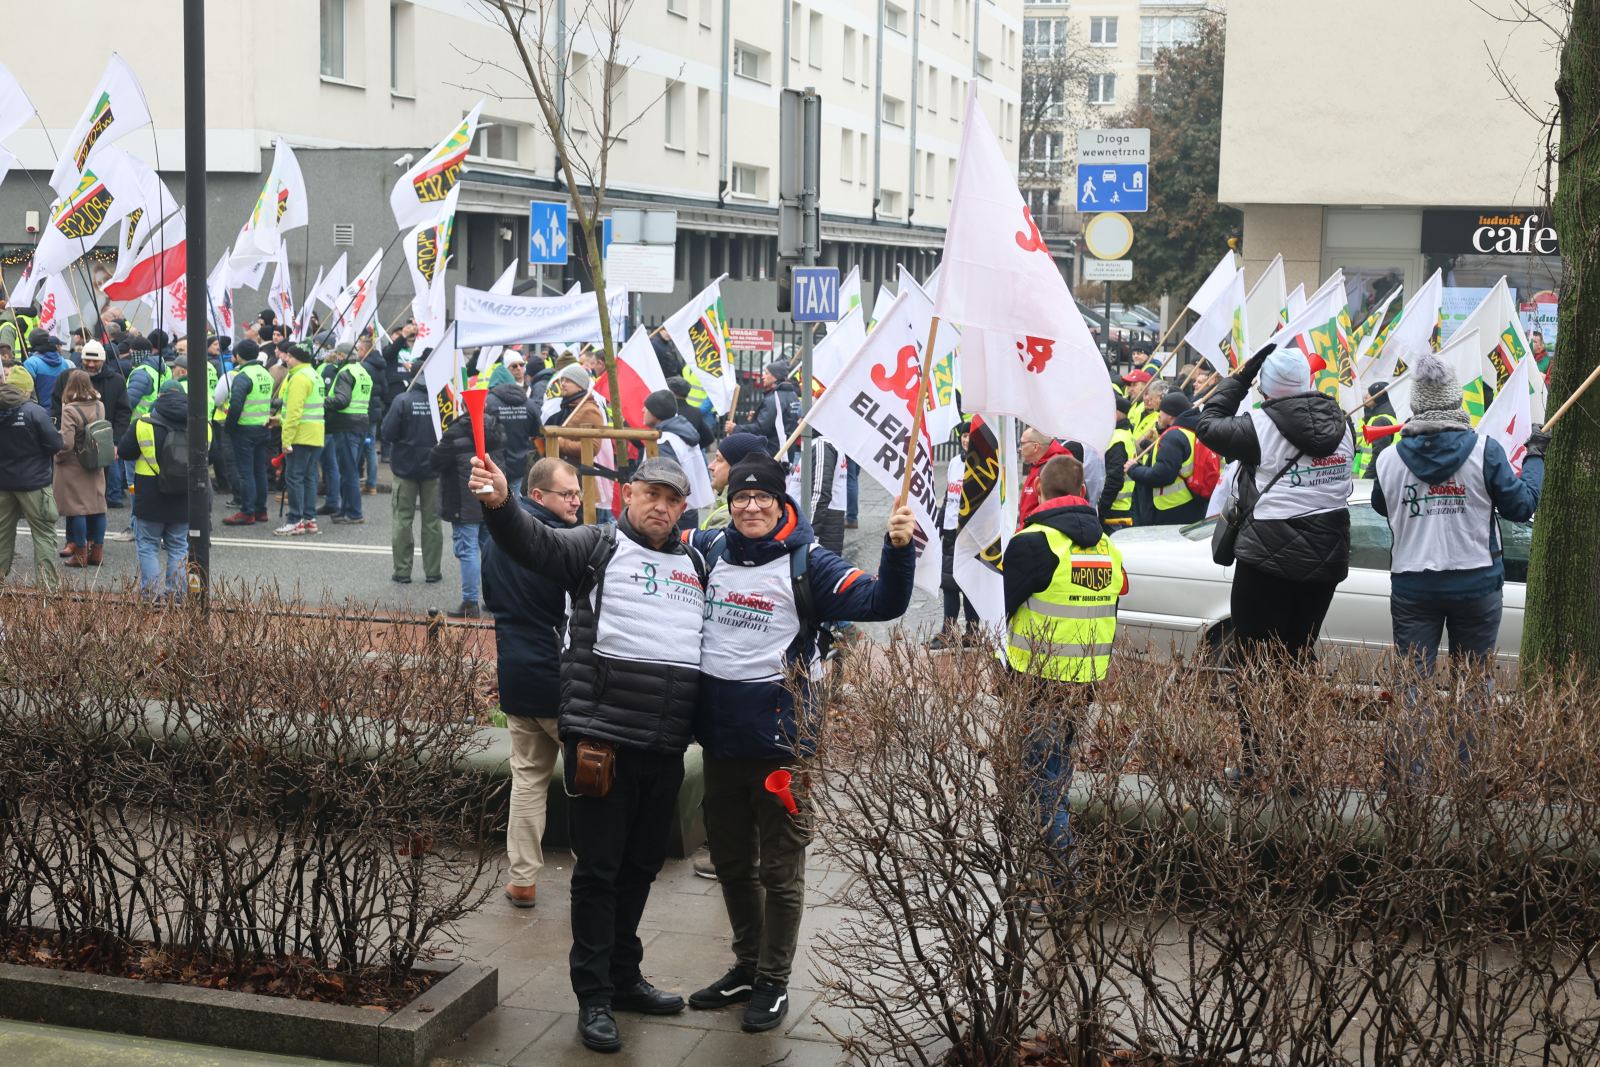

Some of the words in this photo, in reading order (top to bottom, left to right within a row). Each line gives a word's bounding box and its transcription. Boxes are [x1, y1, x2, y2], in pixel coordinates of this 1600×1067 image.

[1097, 134, 1130, 146] Droga
[1082, 148, 1145, 158] wewnętrzna
[1472, 214, 1558, 254] cafe
[796, 276, 836, 314] TAXI
[1072, 567, 1111, 590] wPOLSCE
